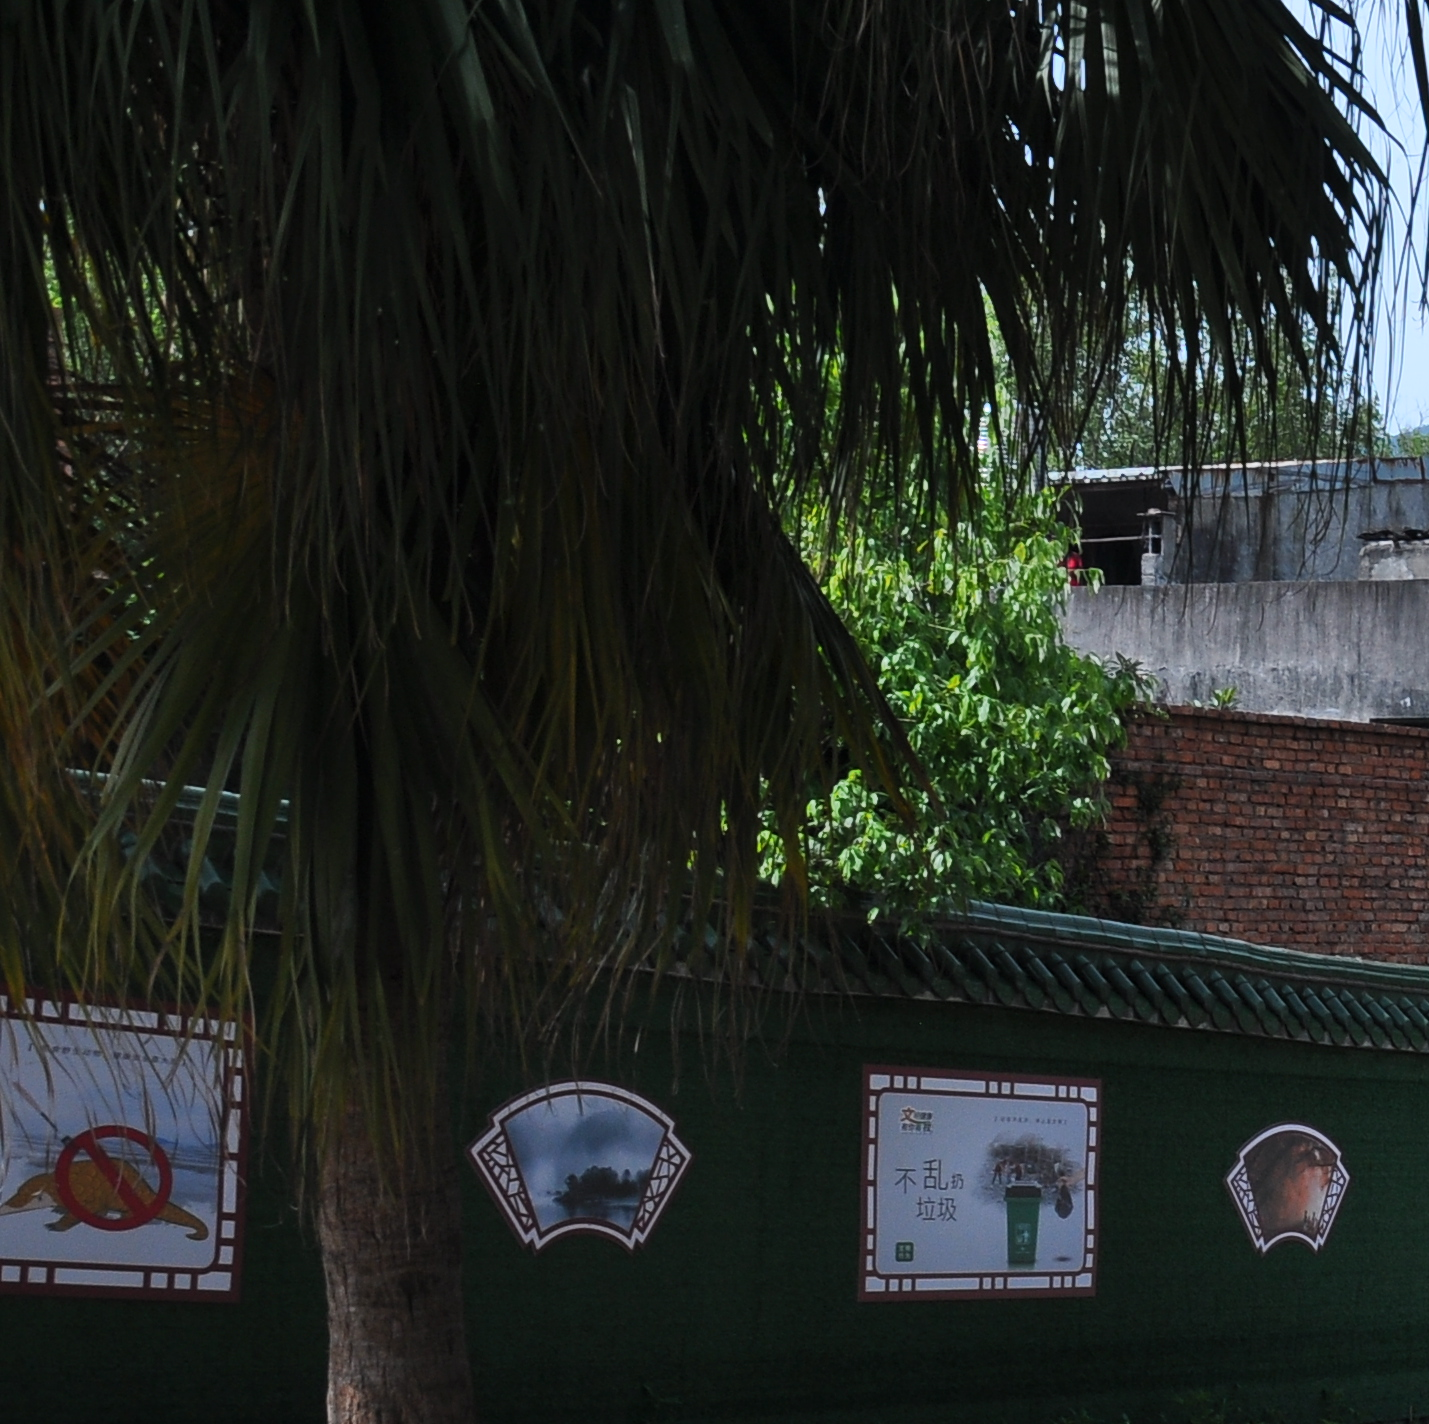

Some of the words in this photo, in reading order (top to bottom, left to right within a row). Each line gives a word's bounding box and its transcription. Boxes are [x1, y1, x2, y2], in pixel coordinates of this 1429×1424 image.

[895, 1158, 964, 1194] 不乱扔
[916, 1197, 957, 1222] 垃圾
